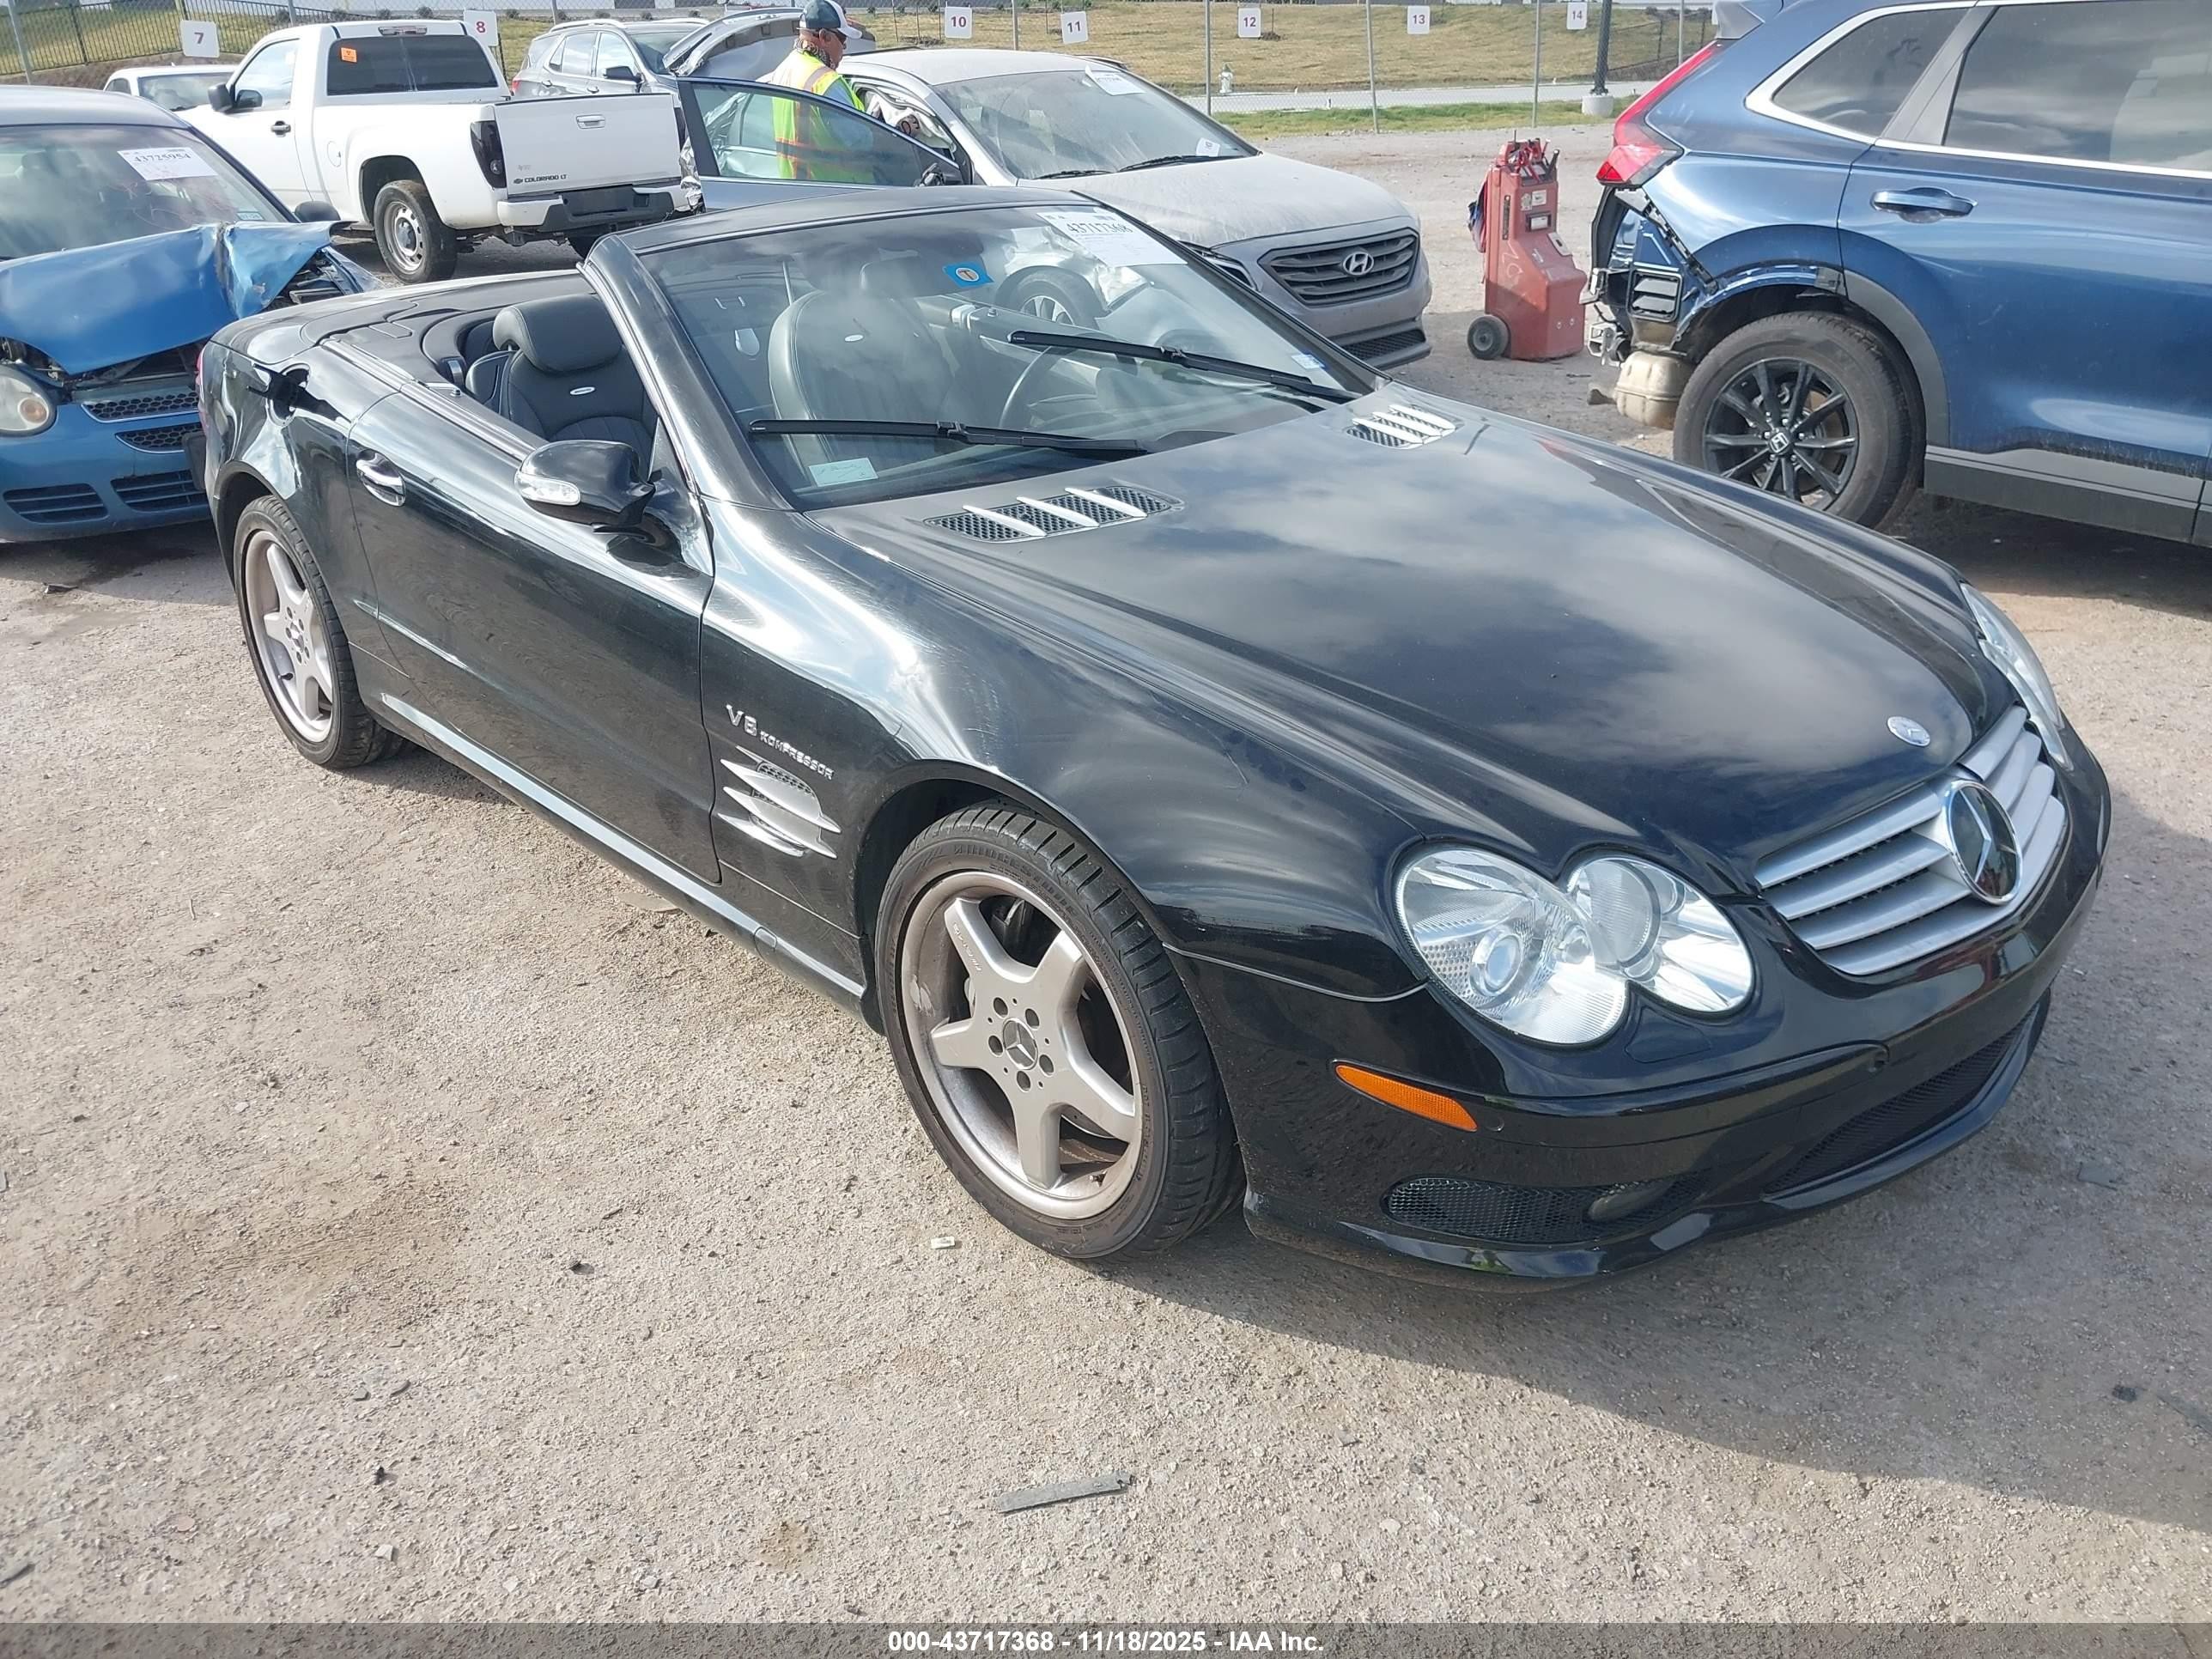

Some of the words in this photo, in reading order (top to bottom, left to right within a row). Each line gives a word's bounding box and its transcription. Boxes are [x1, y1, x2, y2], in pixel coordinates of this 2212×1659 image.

[1413, 15, 1425, 24] 13
[1572, 10, 1583, 20] 14
[476, 21, 486, 33] 8
[951, 16, 967, 27] 10
[1066, 21, 1081, 33] 11
[1243, 17, 1256, 27] 12
[194, 32, 204, 45] 7
[524, 174, 559, 183] COLORADO
[760, 731, 835, 781] KOMPRESSOR
